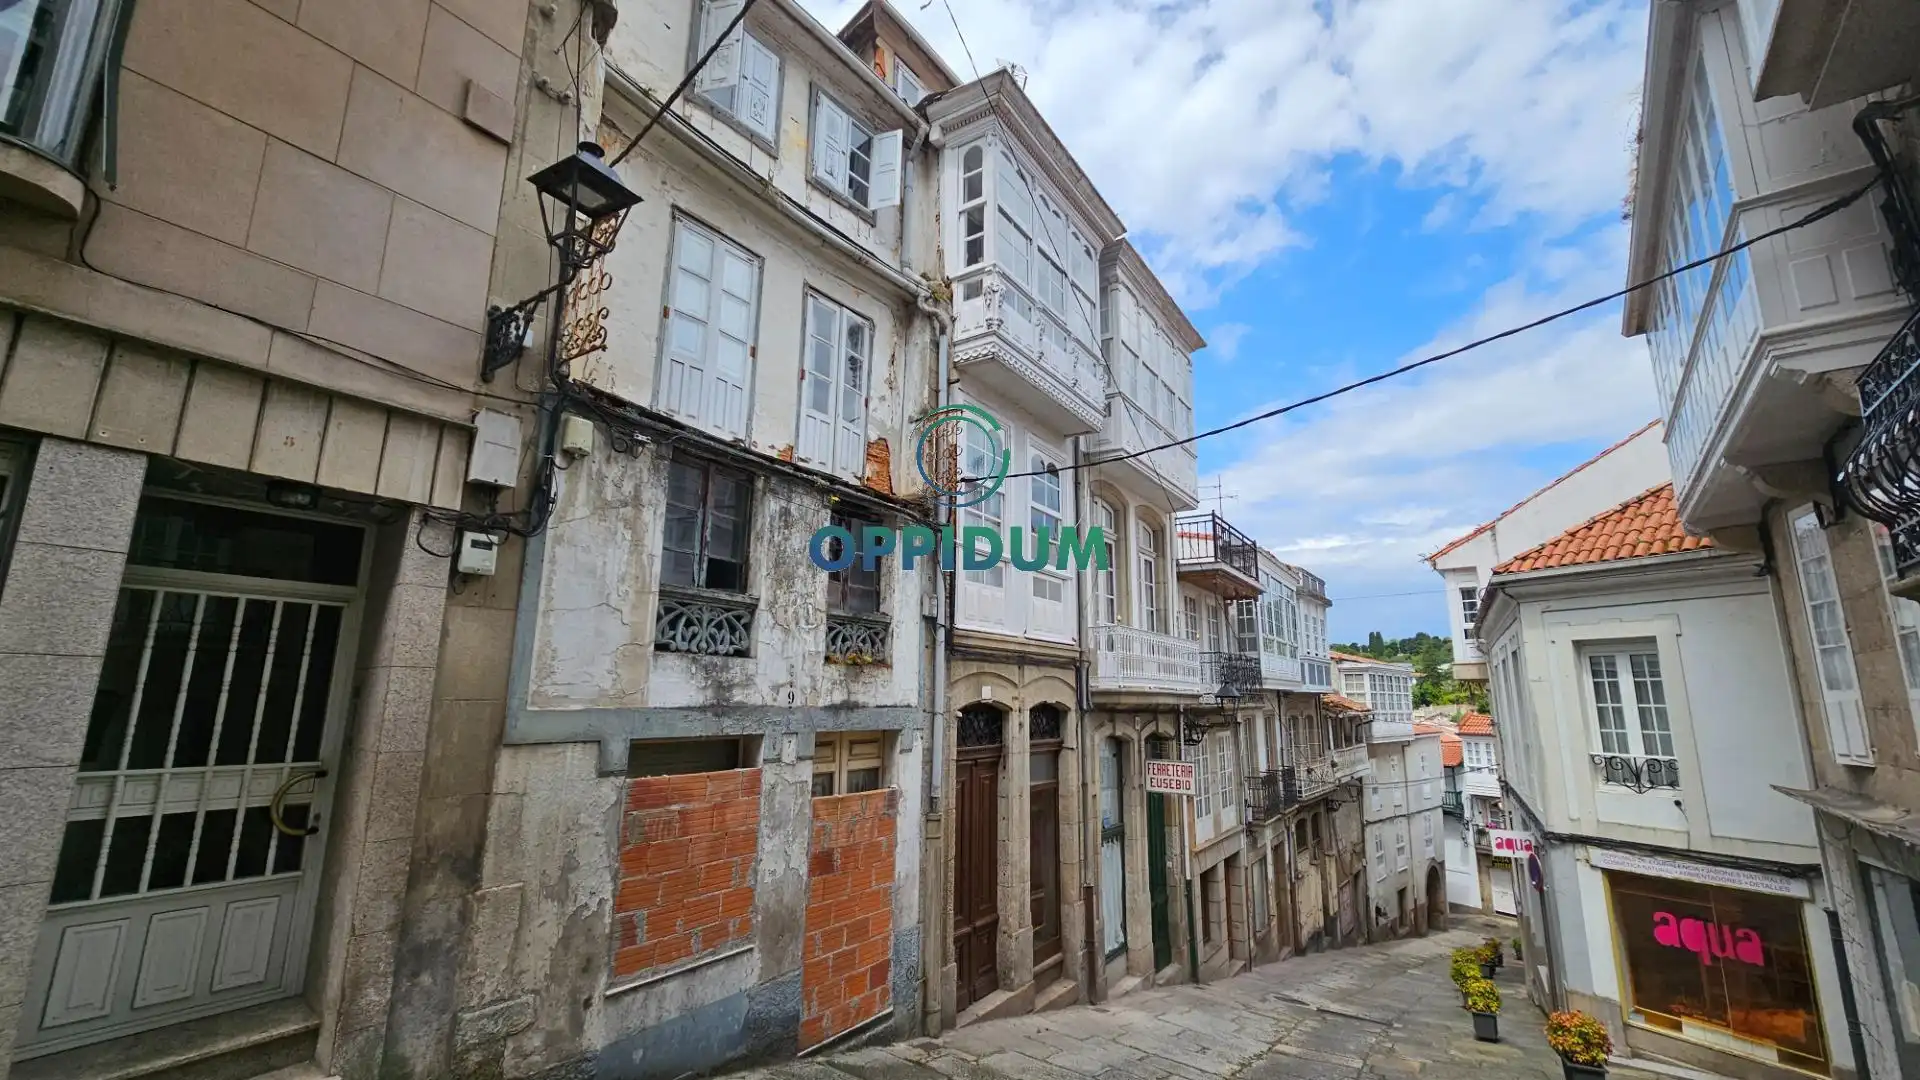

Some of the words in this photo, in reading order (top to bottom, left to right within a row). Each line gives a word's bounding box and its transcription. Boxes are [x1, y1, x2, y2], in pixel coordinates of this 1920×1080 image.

[1147, 762, 1193, 778] FERRETERIA
[1150, 777, 1191, 790] EUSEBIO
[1495, 836, 1532, 855] aqua
[1748, 880, 1791, 893] DETALLES
[1653, 912, 1763, 965] aqua
